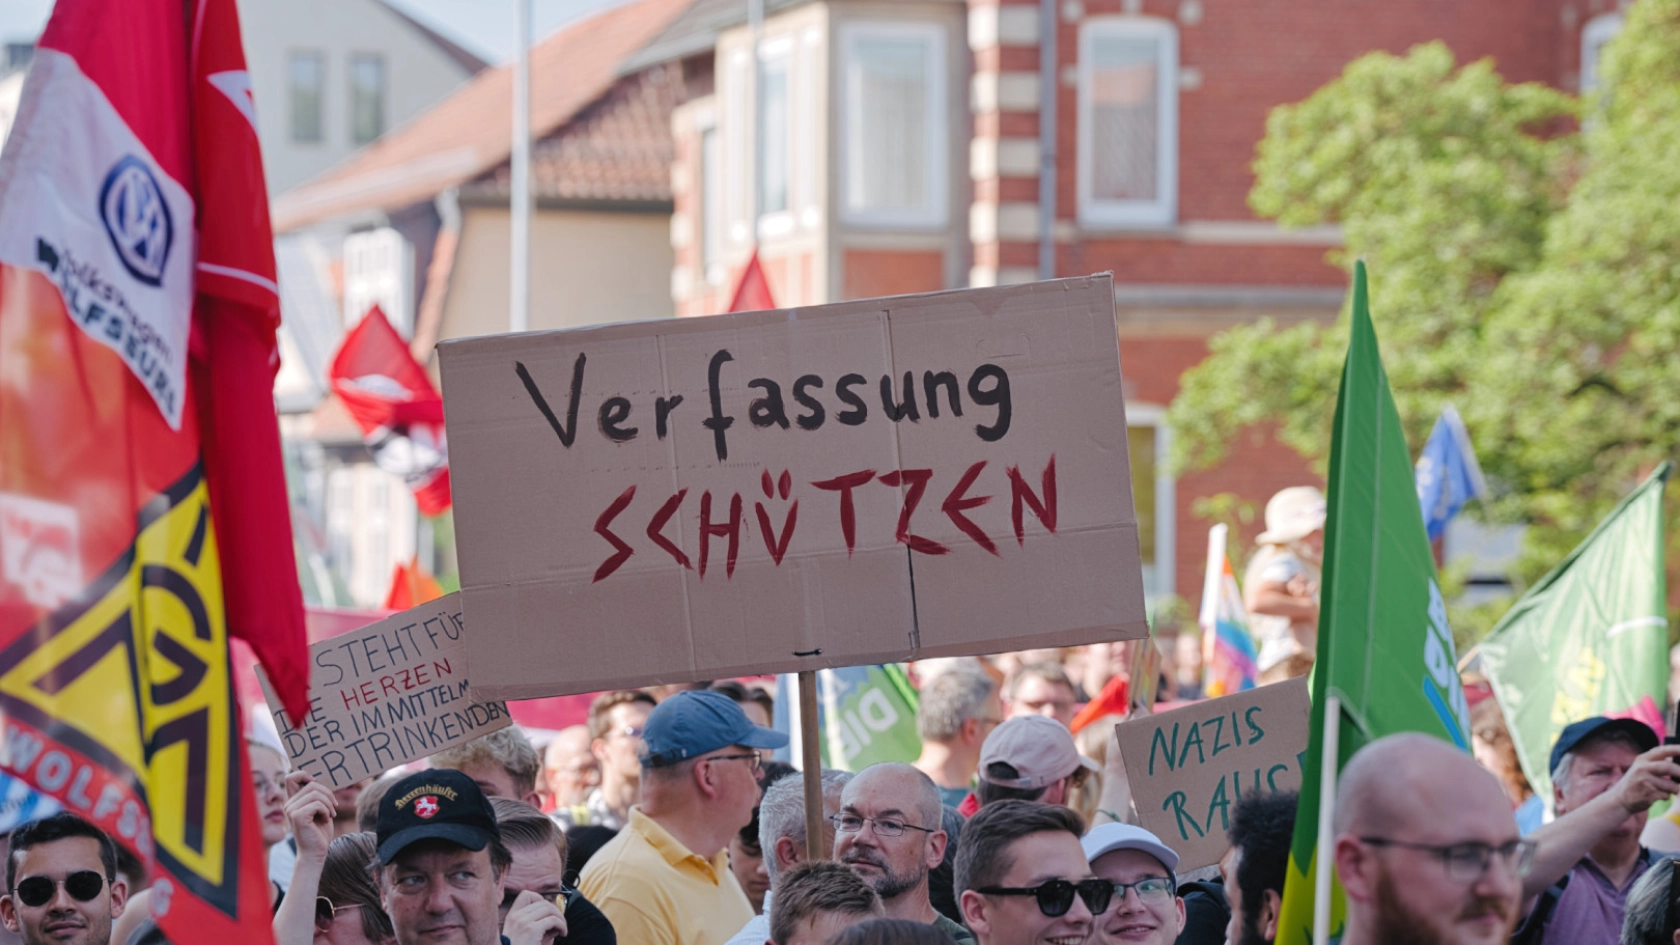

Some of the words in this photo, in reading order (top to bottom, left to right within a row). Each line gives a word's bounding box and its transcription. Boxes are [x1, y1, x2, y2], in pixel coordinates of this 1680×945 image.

[515, 349, 1013, 462] Verfassung
[592, 453, 1058, 584] SCHÜTZEN
[316, 623, 422, 687] STEHT
[340, 658, 452, 711] HERZEN
[284, 720, 345, 759] DER
[351, 706, 384, 736] IM
[1148, 706, 1265, 776] NAZIS
